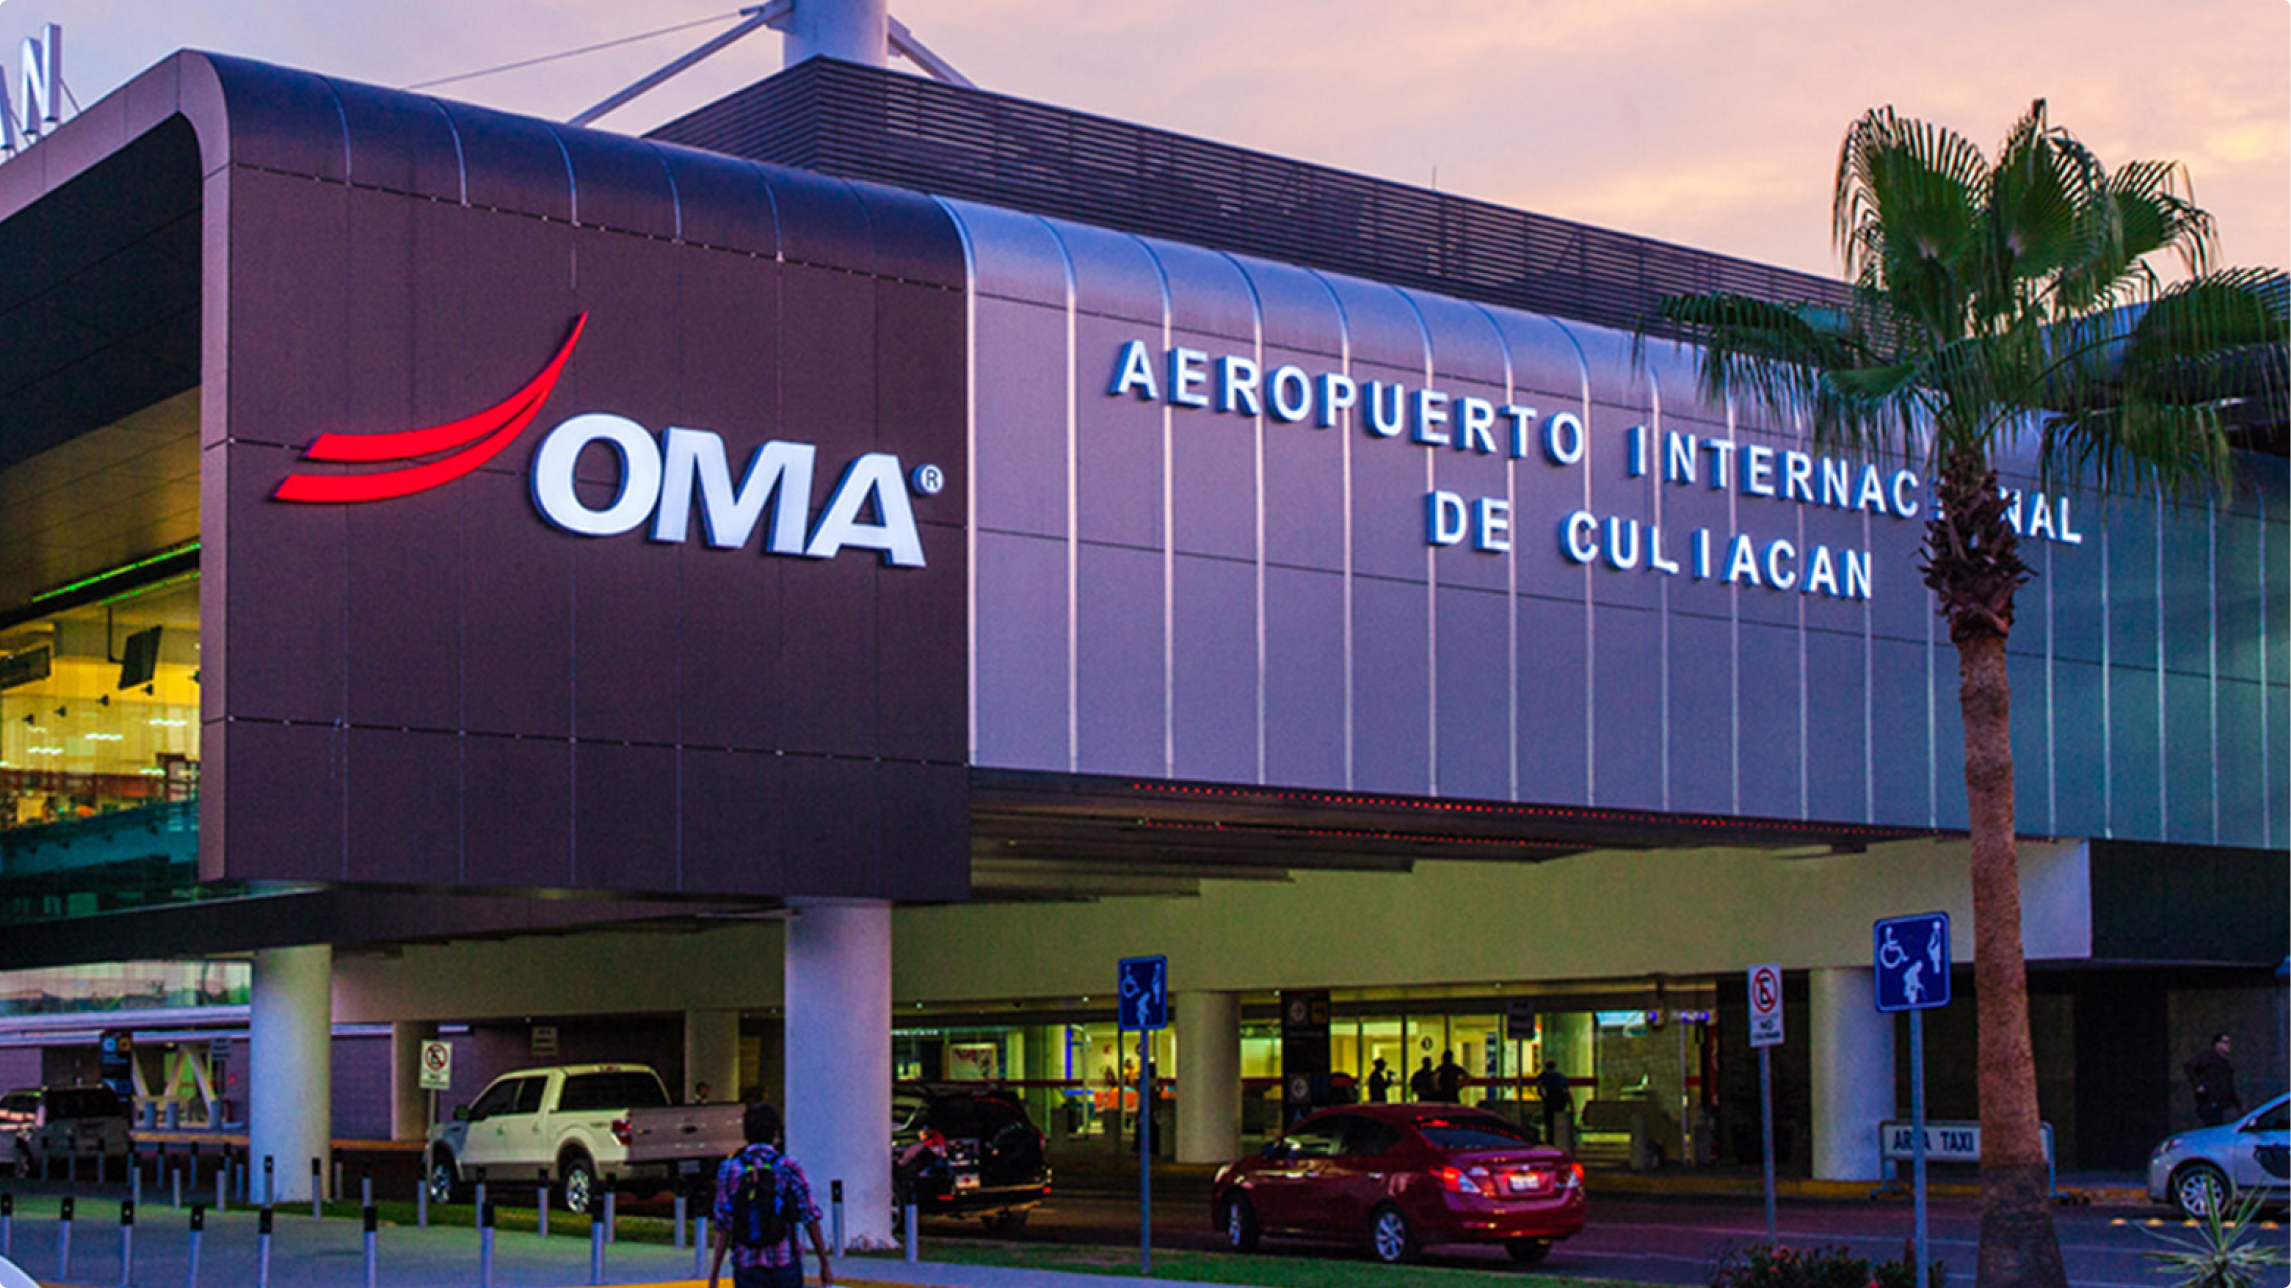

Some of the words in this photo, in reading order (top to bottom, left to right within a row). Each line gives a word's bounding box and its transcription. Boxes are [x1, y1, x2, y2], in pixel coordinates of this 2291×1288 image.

[530, 412, 927, 568] OMA
[1111, 339, 1585, 466] AEROPUERTO
[1629, 424, 2083, 545] INTERNACNAL
[1427, 490, 1511, 551] DE
[1560, 509, 1872, 600] CULIACAN
[1893, 1129, 1931, 1150] ARA
[1940, 1131, 1975, 1152] TAXI
